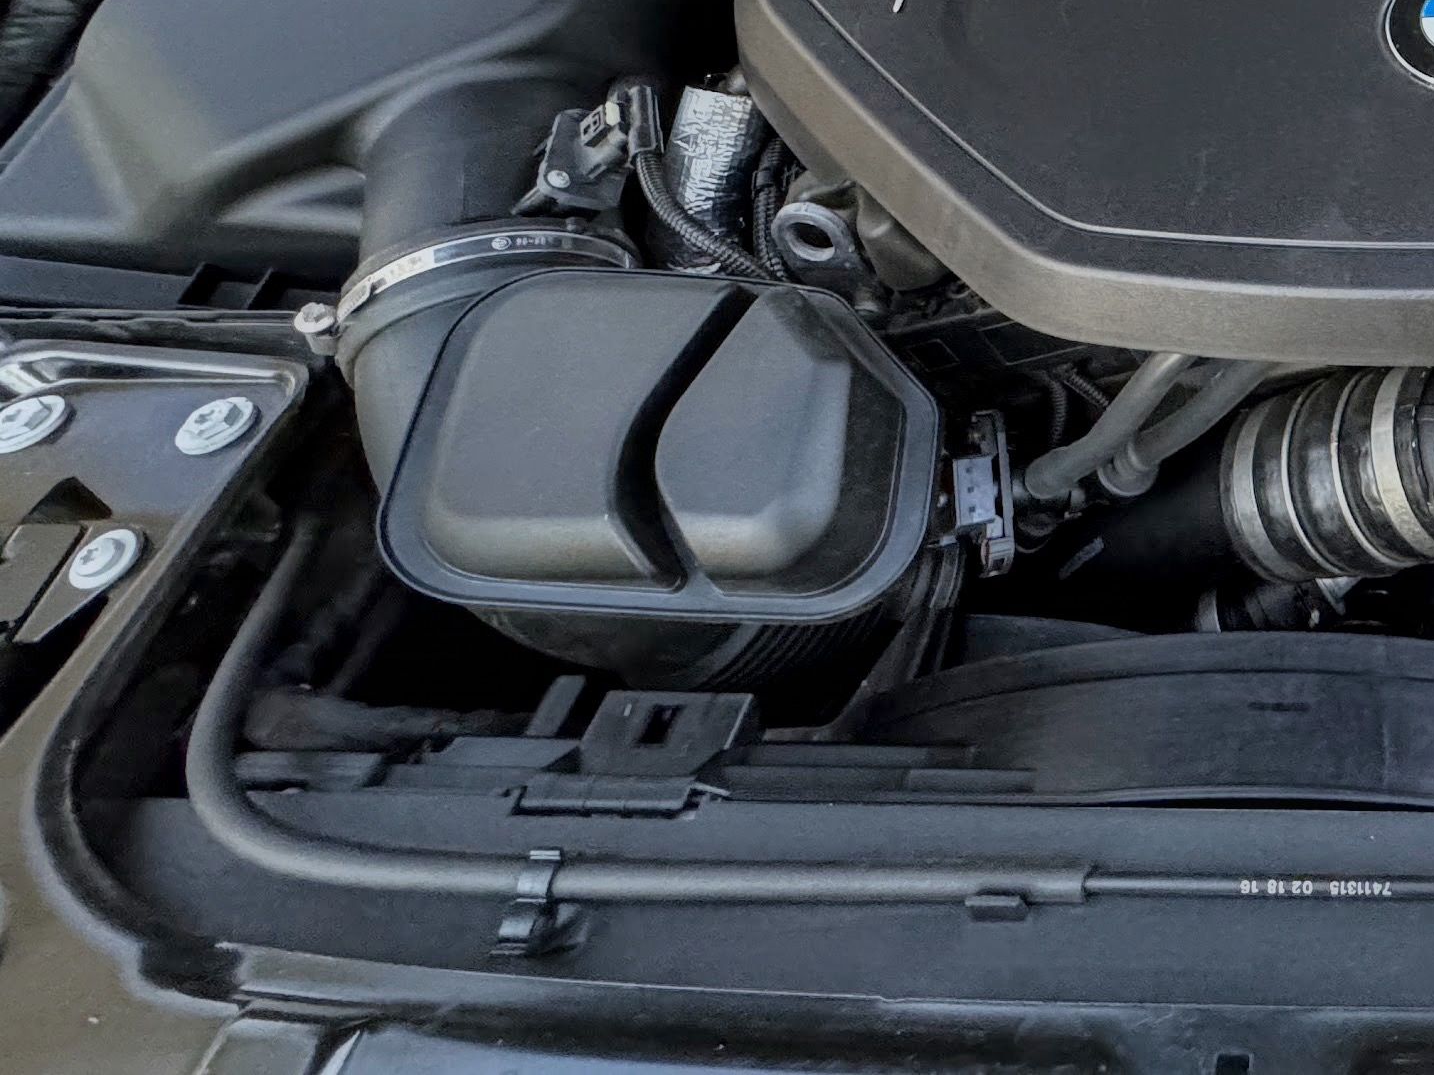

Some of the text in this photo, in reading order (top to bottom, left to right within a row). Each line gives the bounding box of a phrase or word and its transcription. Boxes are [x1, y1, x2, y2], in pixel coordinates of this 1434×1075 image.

[1267, 879, 1286, 894] 18
[1291, 880, 1314, 895] 02
[1329, 880, 1392, 896] 7411315
